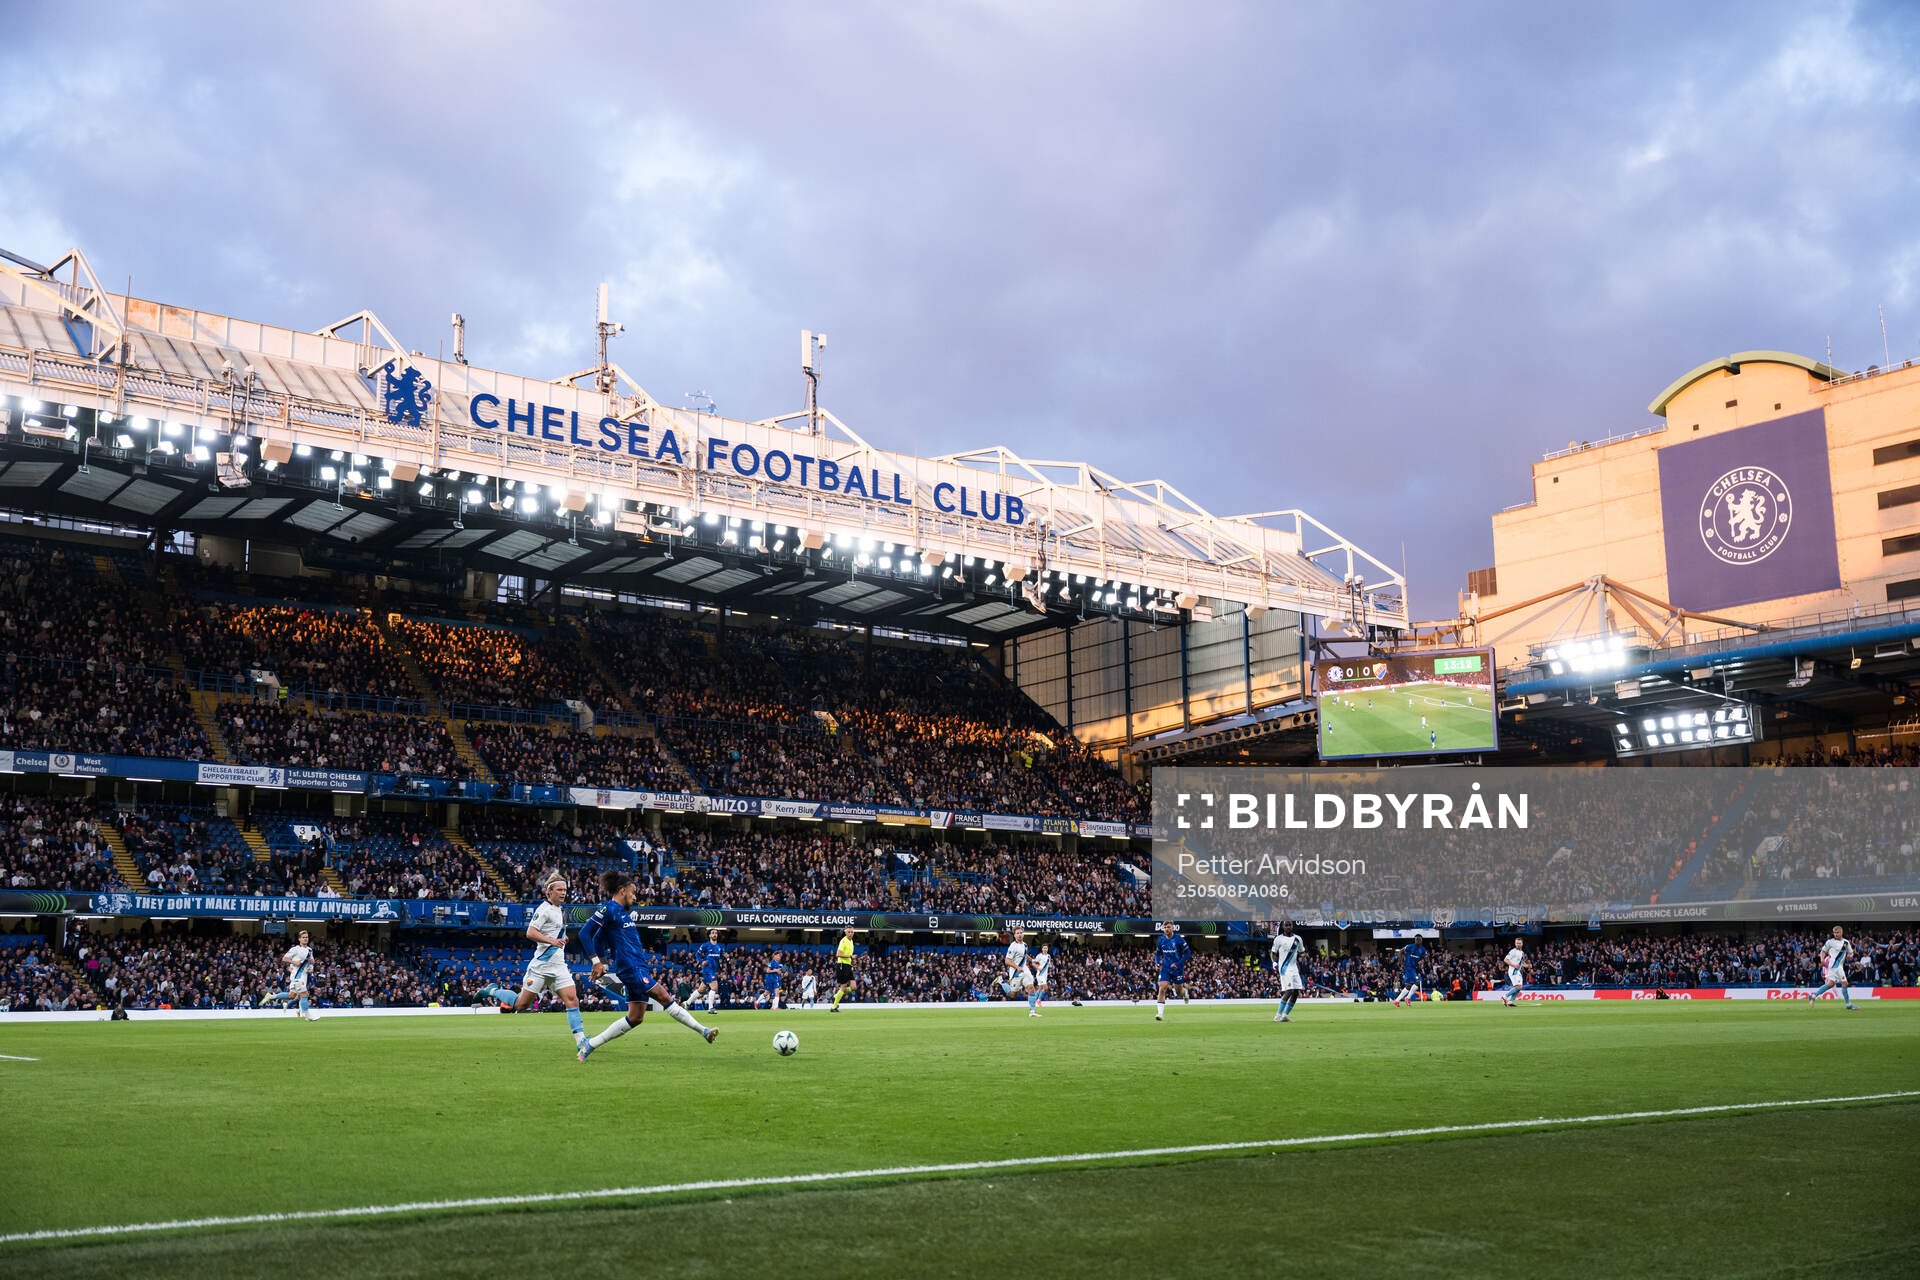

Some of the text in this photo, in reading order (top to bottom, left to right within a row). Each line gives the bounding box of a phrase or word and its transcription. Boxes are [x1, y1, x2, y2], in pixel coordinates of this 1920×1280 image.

[469, 392, 1026, 525] CHELSEA FOOTBALL CLUB
[1713, 470, 1771, 498] CHELSEA
[1717, 535, 1778, 560] FOOTBALL CLUB
[16, 757, 48, 766] Chelsea
[83, 757, 101, 765] West
[76, 765, 107, 773] Midlands
[202, 766, 232, 774] CHELSEA
[202, 773, 246, 781] SUPPORTERS
[302, 771, 328, 779] ULSTER
[329, 773, 362, 782] CHELSEA
[287, 778, 348, 788] Supporters Club
[654, 793, 695, 803] THAILAND
[669, 802, 695, 810] BLUES
[712, 798, 748, 813] MIZO
[775, 804, 796, 814] Kerry
[954, 814, 982, 823] FRANCE
[135, 896, 371, 914] THEY DON'T MAKE THEM LIKE RAY ANYMORE
[1784, 903, 1818, 912] STRAUSS
[1890, 898, 1919, 908] UEFA
[1617, 909, 1671, 920] CONFERENCE
[1673, 907, 1708, 917] LEAGUE
[736, 914, 855, 925] UEFA CONFERENCE LEAGUE
[1005, 919, 1102, 930] UEFA CONFERENCE LEAGUE
[1631, 990, 1692, 1000] Beno
[1767, 989, 1835, 1000] Betao
